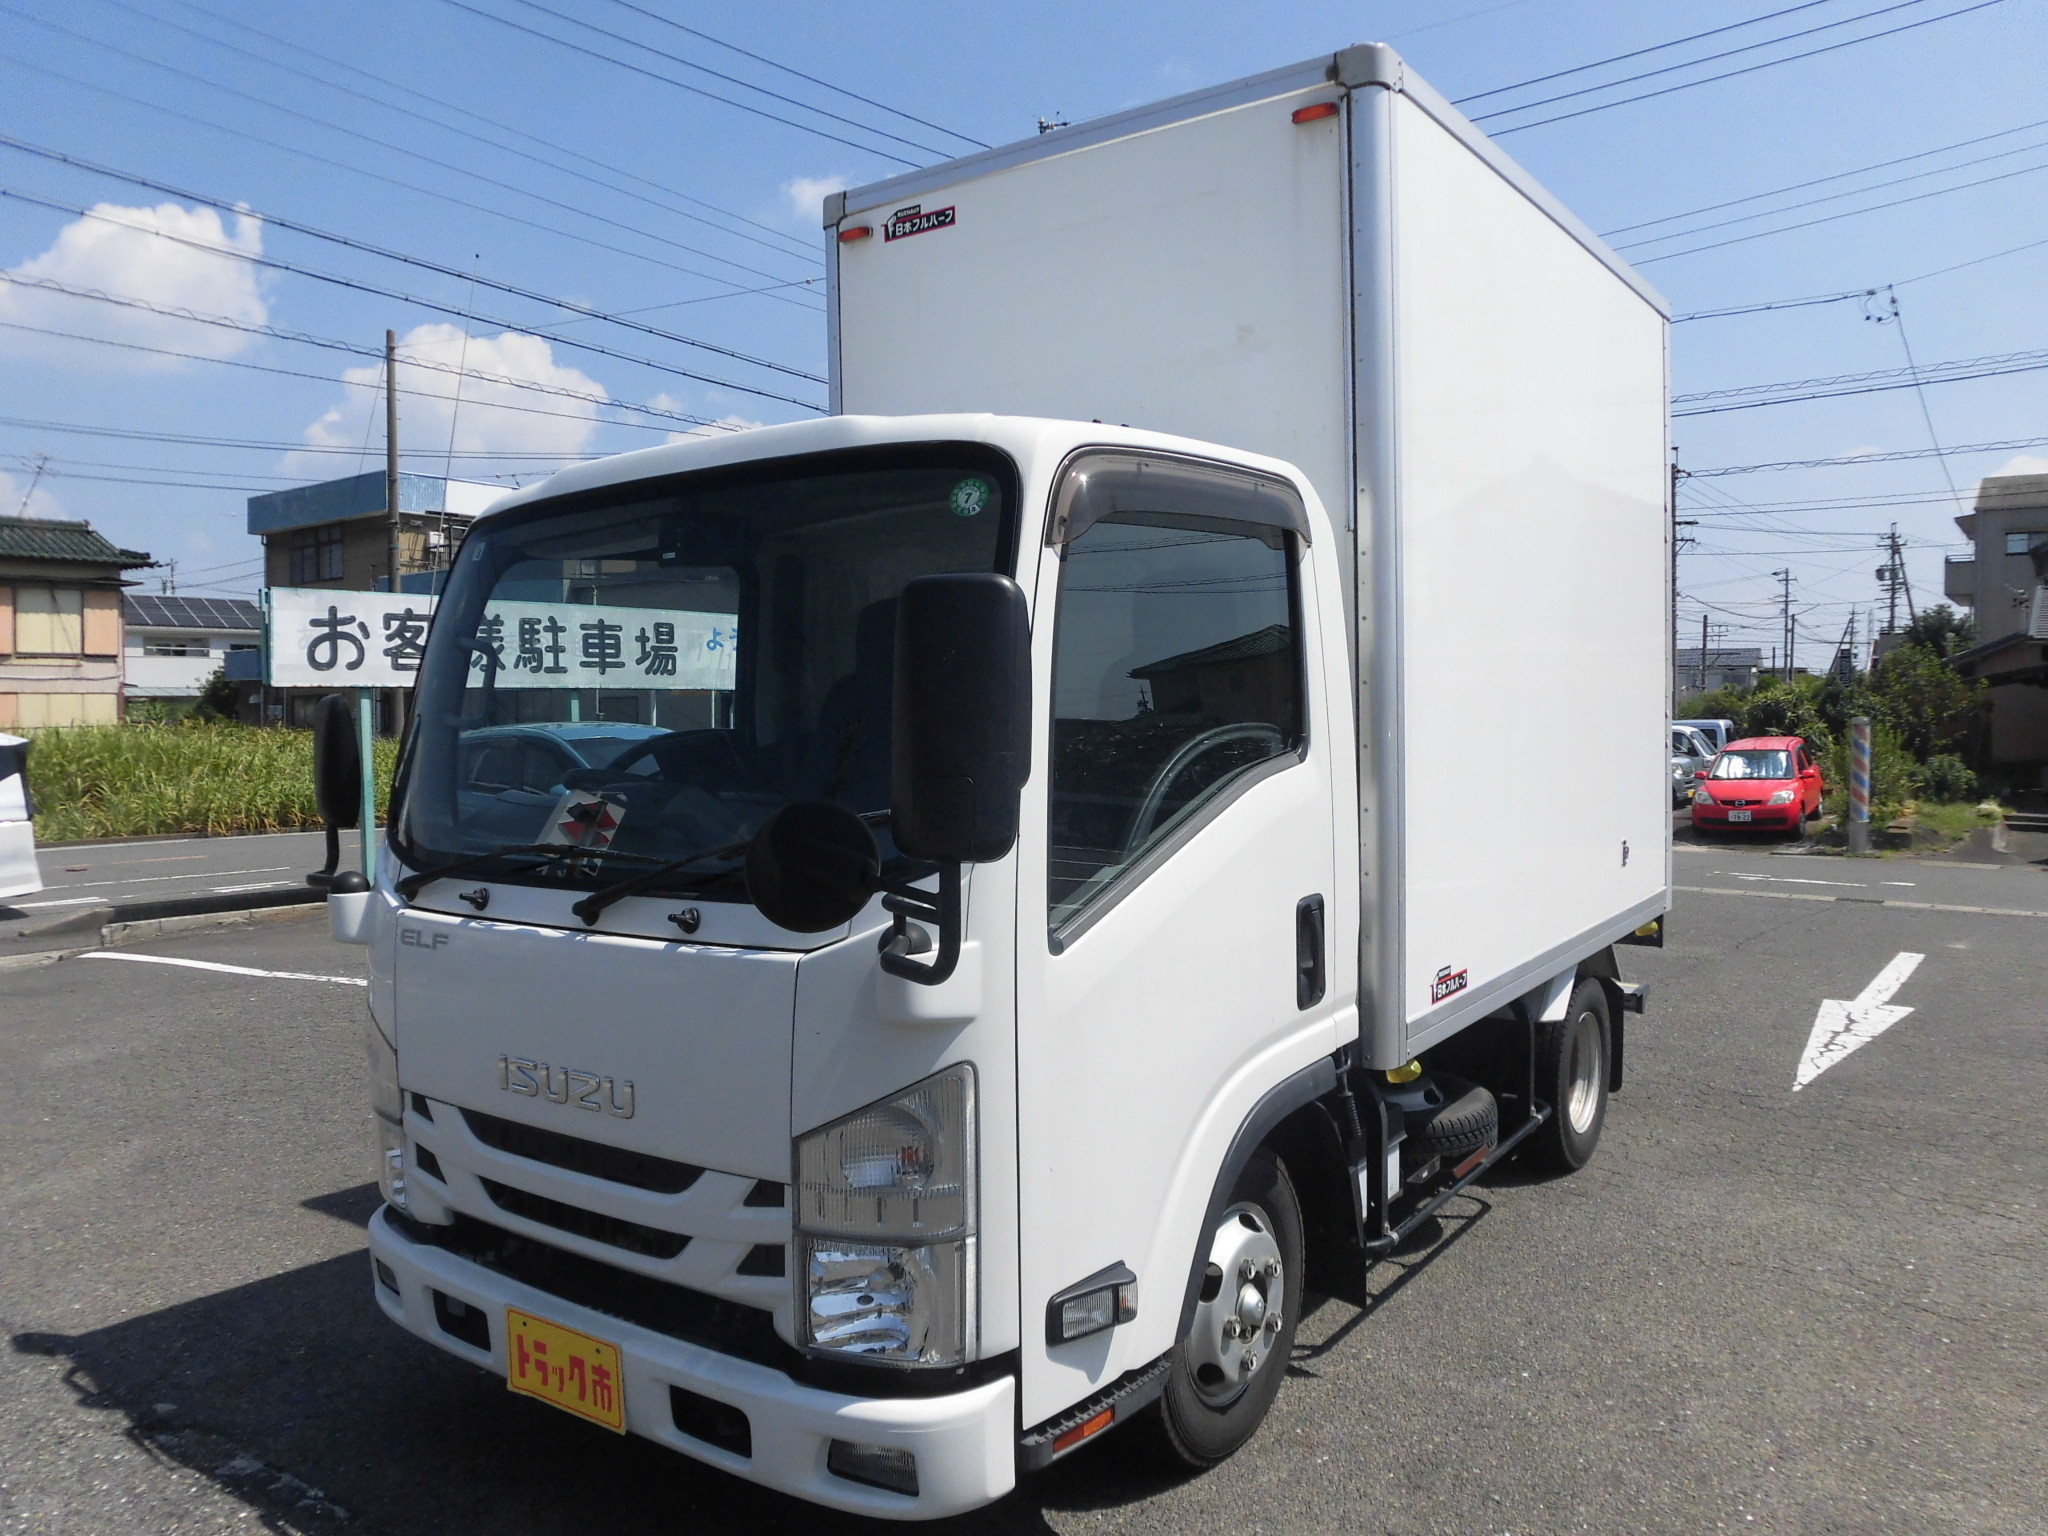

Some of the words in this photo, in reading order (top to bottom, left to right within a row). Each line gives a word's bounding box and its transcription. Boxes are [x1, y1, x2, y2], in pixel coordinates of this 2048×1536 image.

[895, 209, 954, 237] 日本フルハーフ
[964, 492, 973, 504] 7
[400, 927, 450, 951] ELF
[498, 1053, 636, 1119] ISUZU
[516, 1333, 613, 1413] トラック市
